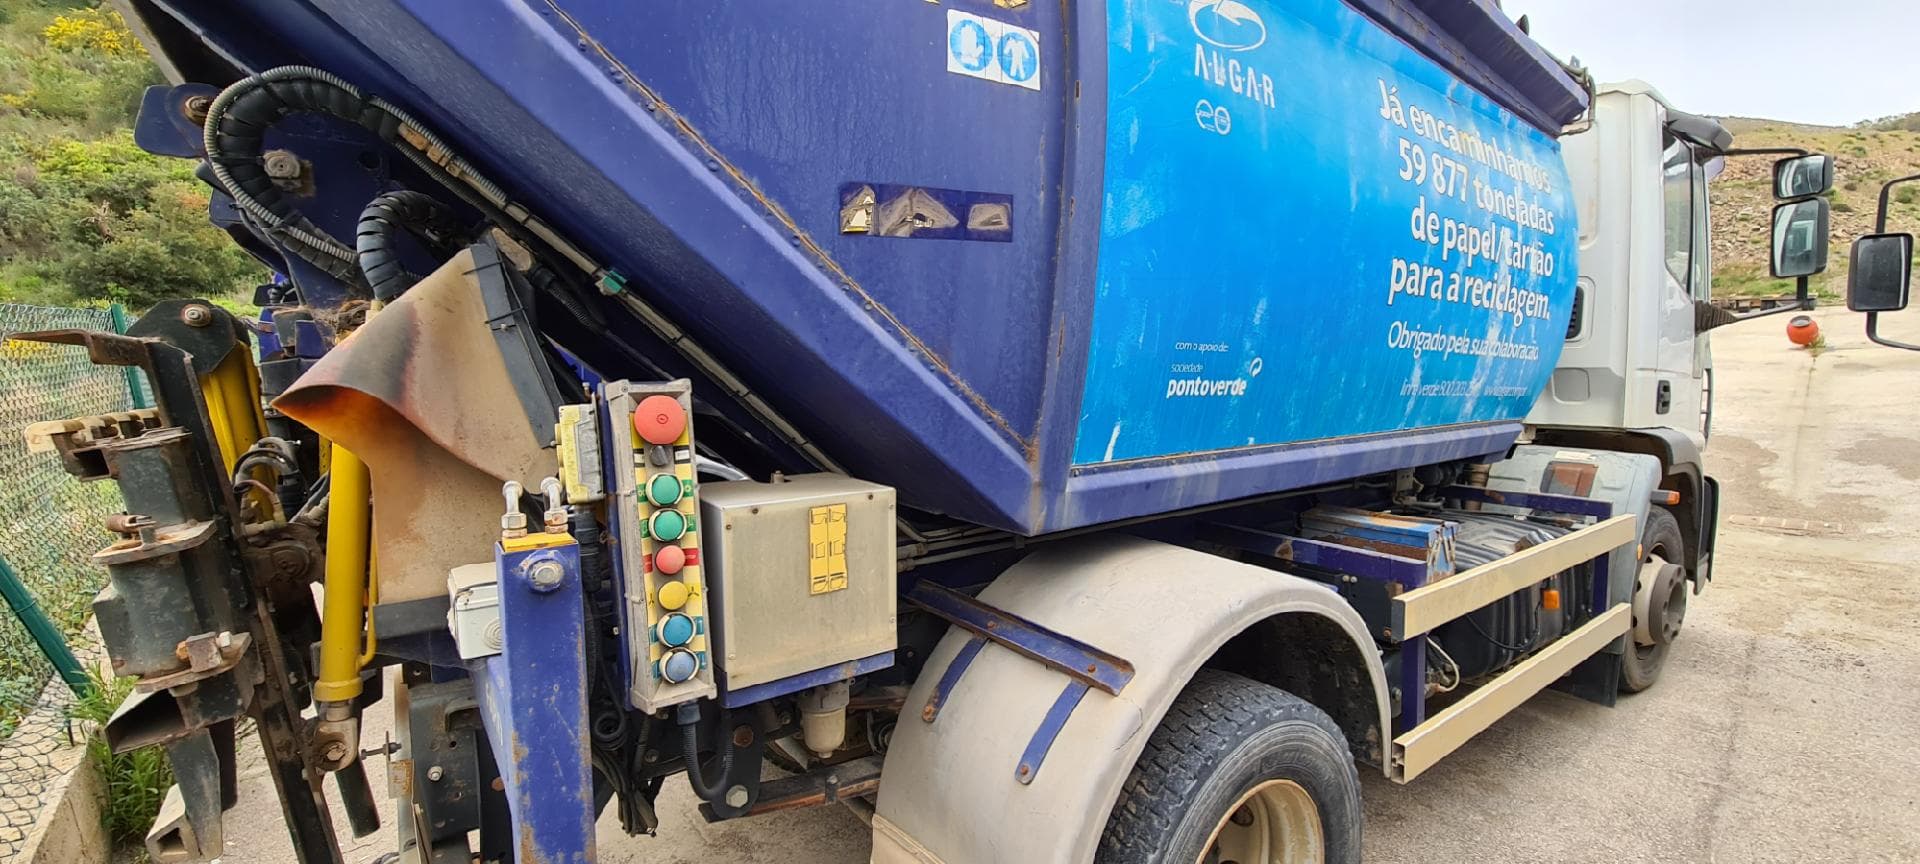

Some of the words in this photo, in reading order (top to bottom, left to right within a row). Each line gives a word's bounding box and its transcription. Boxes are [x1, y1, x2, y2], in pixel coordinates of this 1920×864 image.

[1378, 77, 1407, 129] Já
[1399, 138, 1427, 185] 59
[1431, 153, 1469, 202] 877
[1473, 175, 1555, 235] toneladas
[1411, 196, 1441, 245] de
[1442, 217, 1554, 277] papel/cartão
[1388, 258, 1444, 305] para
[1447, 272, 1460, 303] a
[1464, 272, 1550, 327] reciclagem.
[1175, 342, 1192, 350] com
[1198, 343, 1218, 355] apoio
[1388, 320, 1447, 359] Obrigado
[1443, 328, 1470, 361] pela
[1470, 338, 1489, 355] sua
[1171, 362, 1203, 373] sociedade
